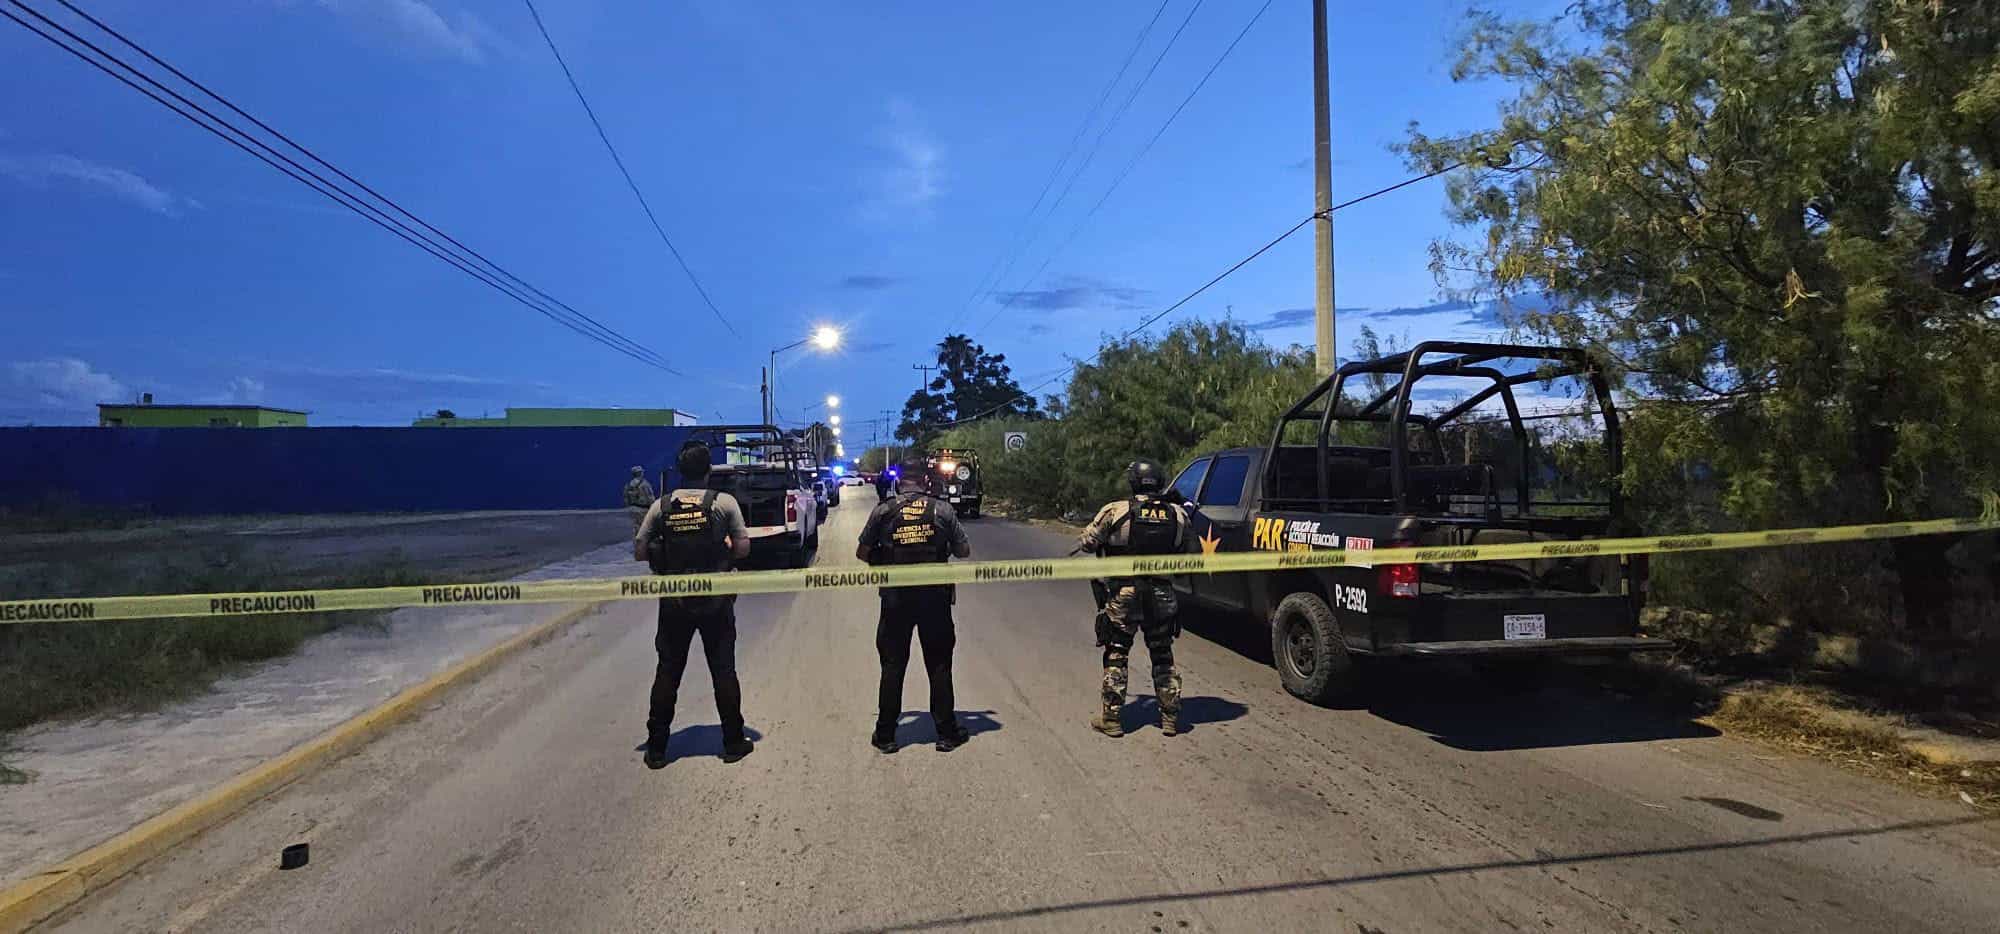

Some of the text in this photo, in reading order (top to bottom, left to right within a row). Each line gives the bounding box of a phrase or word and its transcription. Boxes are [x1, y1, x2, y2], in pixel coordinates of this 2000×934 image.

[1141, 508, 1167, 519] PAR
[1253, 517, 1285, 551] PAR
[0, 602, 96, 620] ECAUCION
[210, 594, 316, 613] PRECAUCION
[422, 585, 521, 603] PRECAUCION
[621, 579, 713, 595] PRECAUCION
[805, 572, 889, 588] PRECAUCION
[975, 565, 1053, 579] PRECAUCION
[1132, 559, 1205, 572] PRECAUCION
[1278, 554, 1346, 566] PRECAUCION
[1415, 549, 1479, 561] PRECAUCION
[1541, 544, 1601, 555] PRECAUCION
[1335, 583, 1368, 614] P-2592
